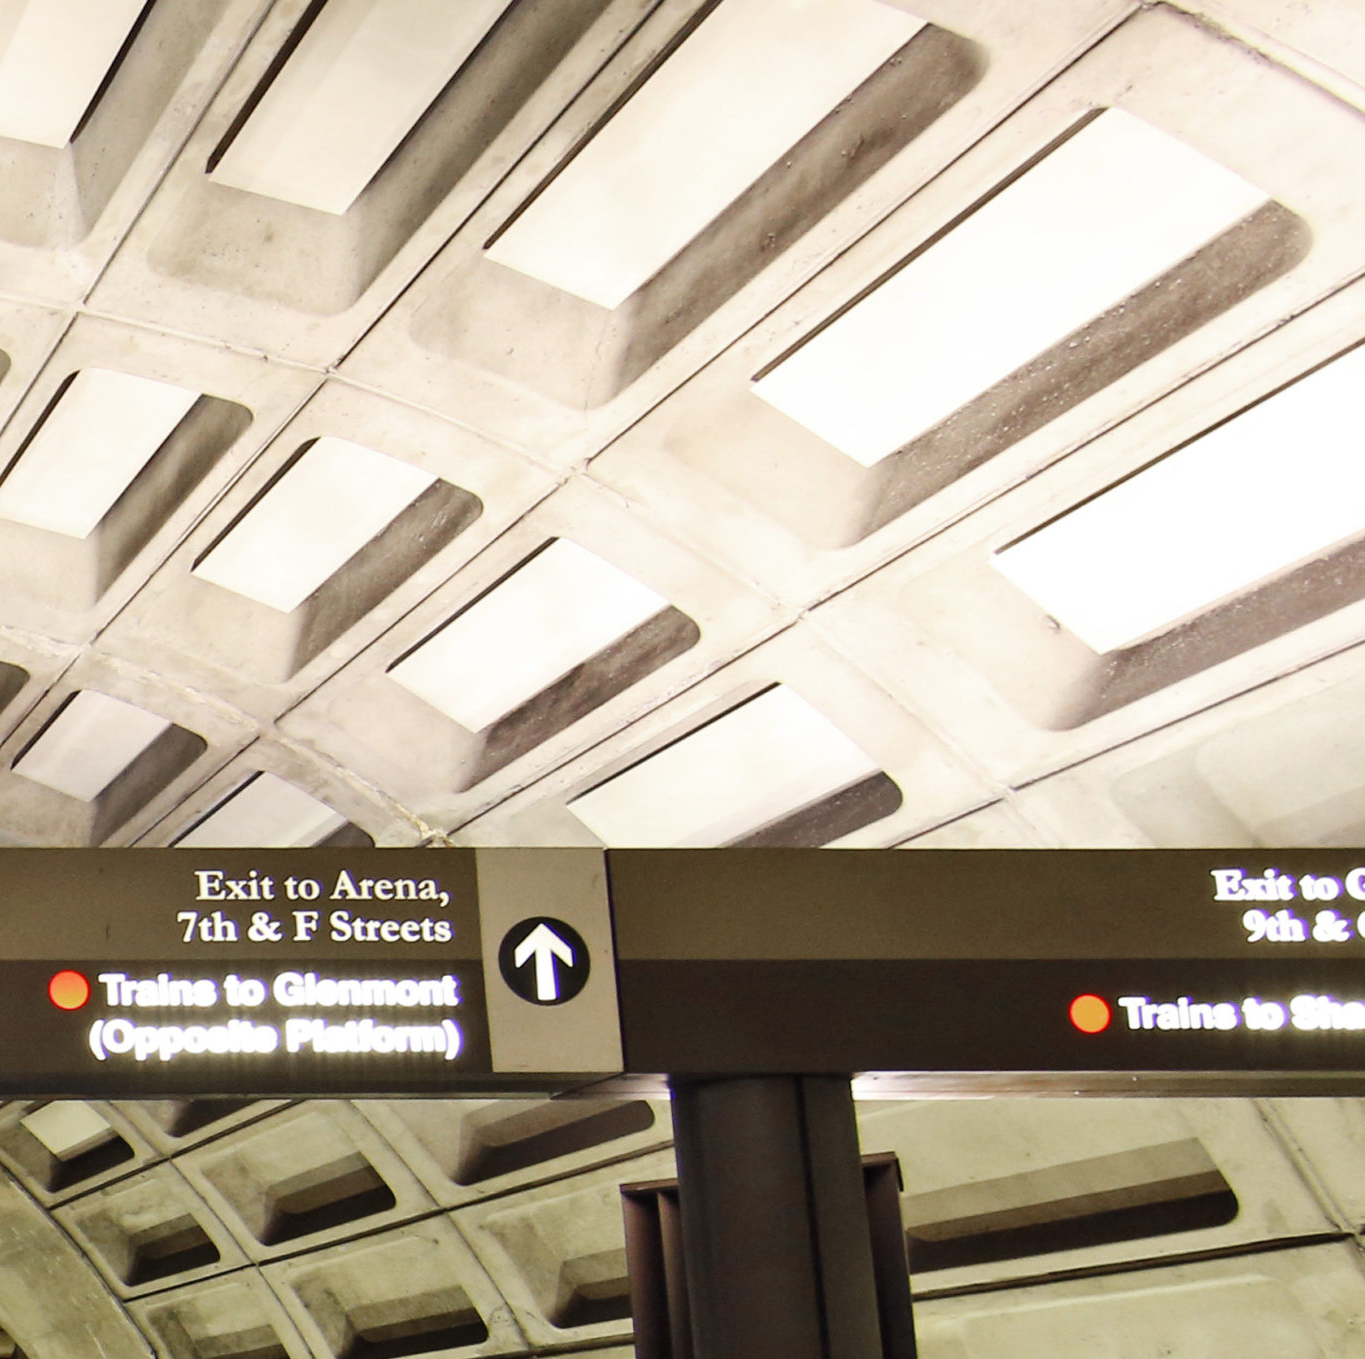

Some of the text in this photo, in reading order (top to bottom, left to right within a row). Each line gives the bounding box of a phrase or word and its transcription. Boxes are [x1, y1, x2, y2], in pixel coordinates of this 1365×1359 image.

[194, 870, 450, 907] Exit to Arena,
[1210, 868, 1295, 901] Exit
[1299, 874, 1341, 901] to
[177, 911, 452, 942] 7th & F Streets
[1242, 909, 1306, 942] 9th
[1312, 910, 1352, 942] &
[98, 971, 460, 1007] Trains to Glenmont
[1118, 994, 1241, 1031] Trains
[1242, 995, 1288, 1031] to
[89, 1018, 462, 1060] (Opposite Platform)
